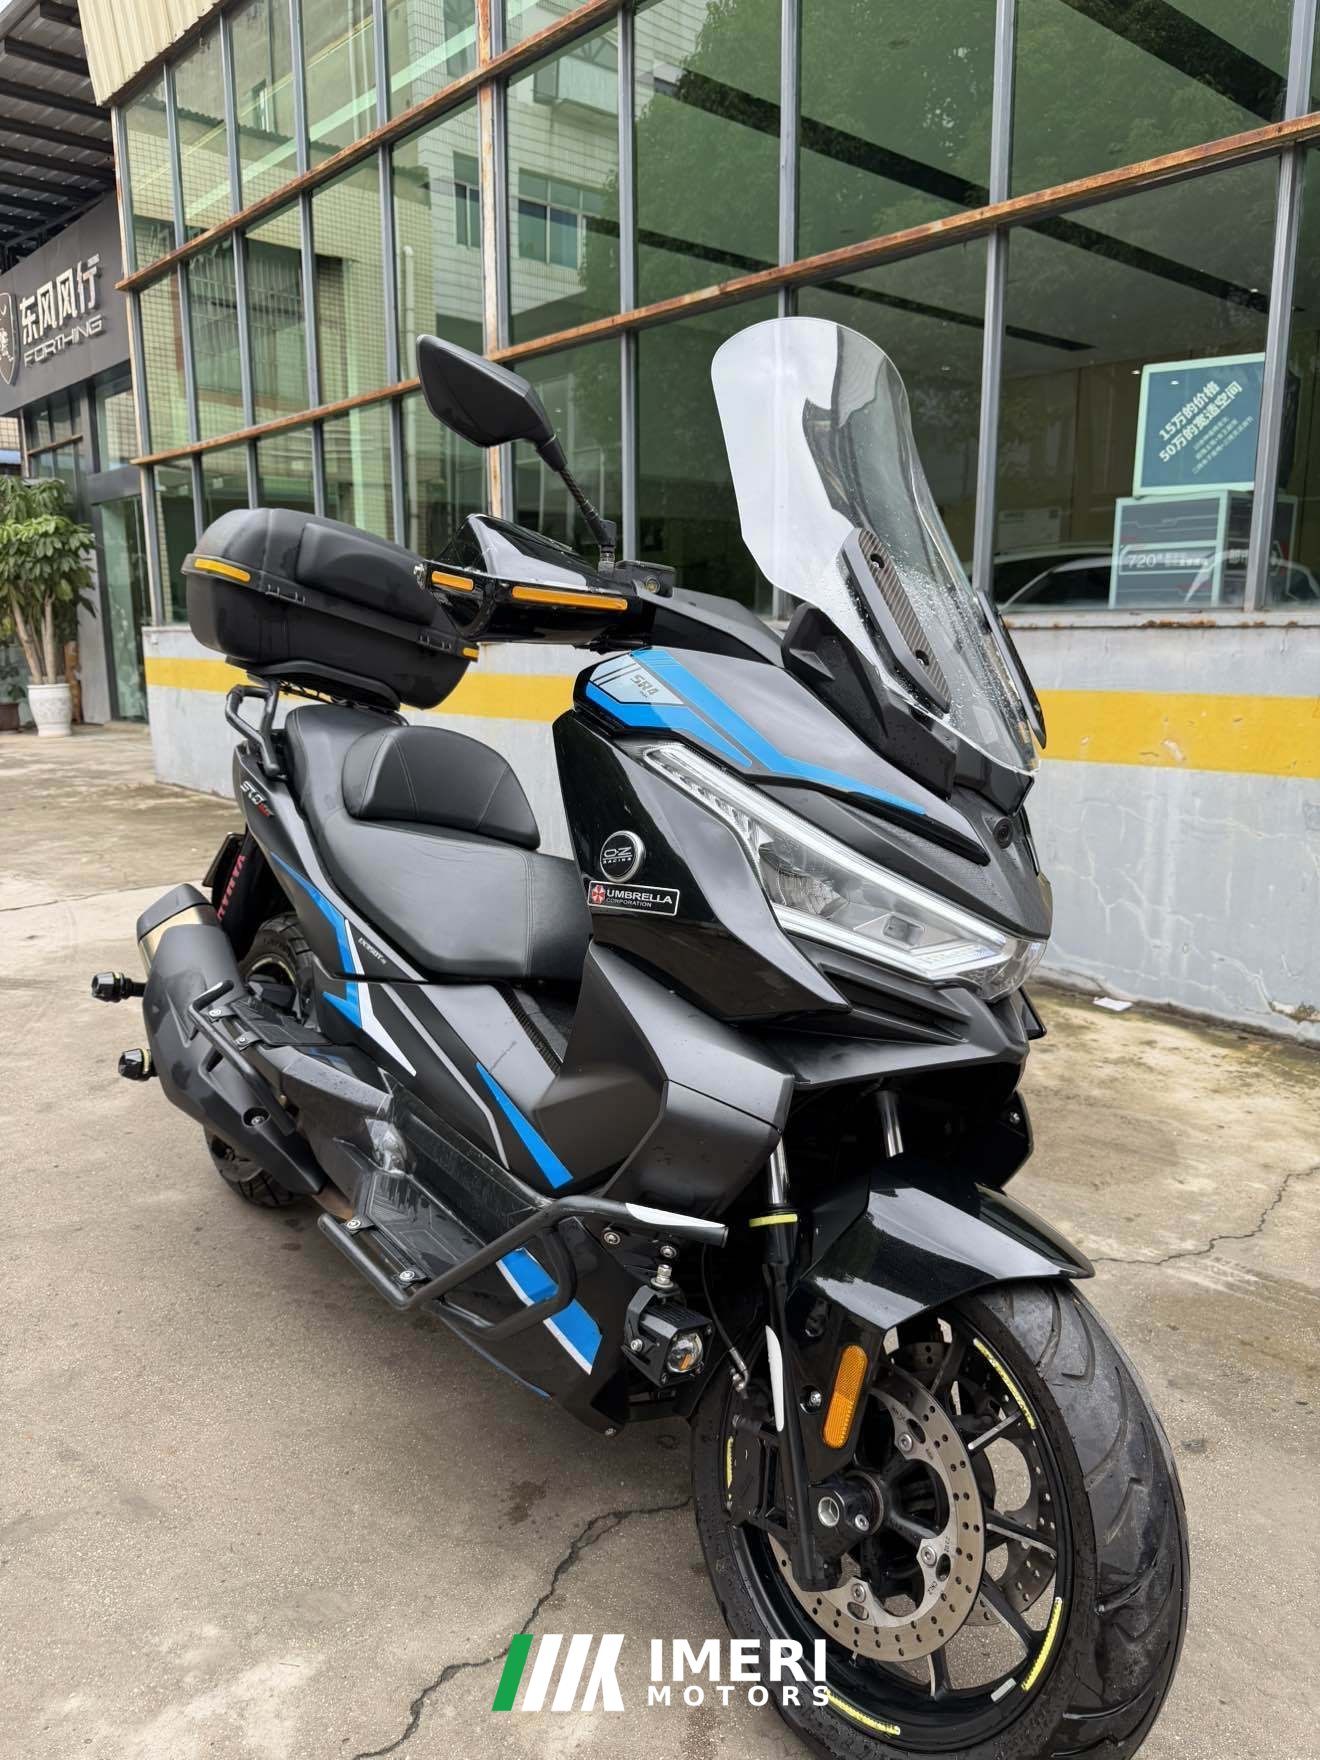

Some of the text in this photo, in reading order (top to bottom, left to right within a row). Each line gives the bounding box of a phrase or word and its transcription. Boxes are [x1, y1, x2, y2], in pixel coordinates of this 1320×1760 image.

[20, 253, 100, 345] 东风风行
[24, 314, 103, 368] FORTHING
[1159, 380, 1220, 441] 15万的价格
[606, 889, 673, 904] UMBRELLA
[606, 898, 652, 908] CORPORATION
